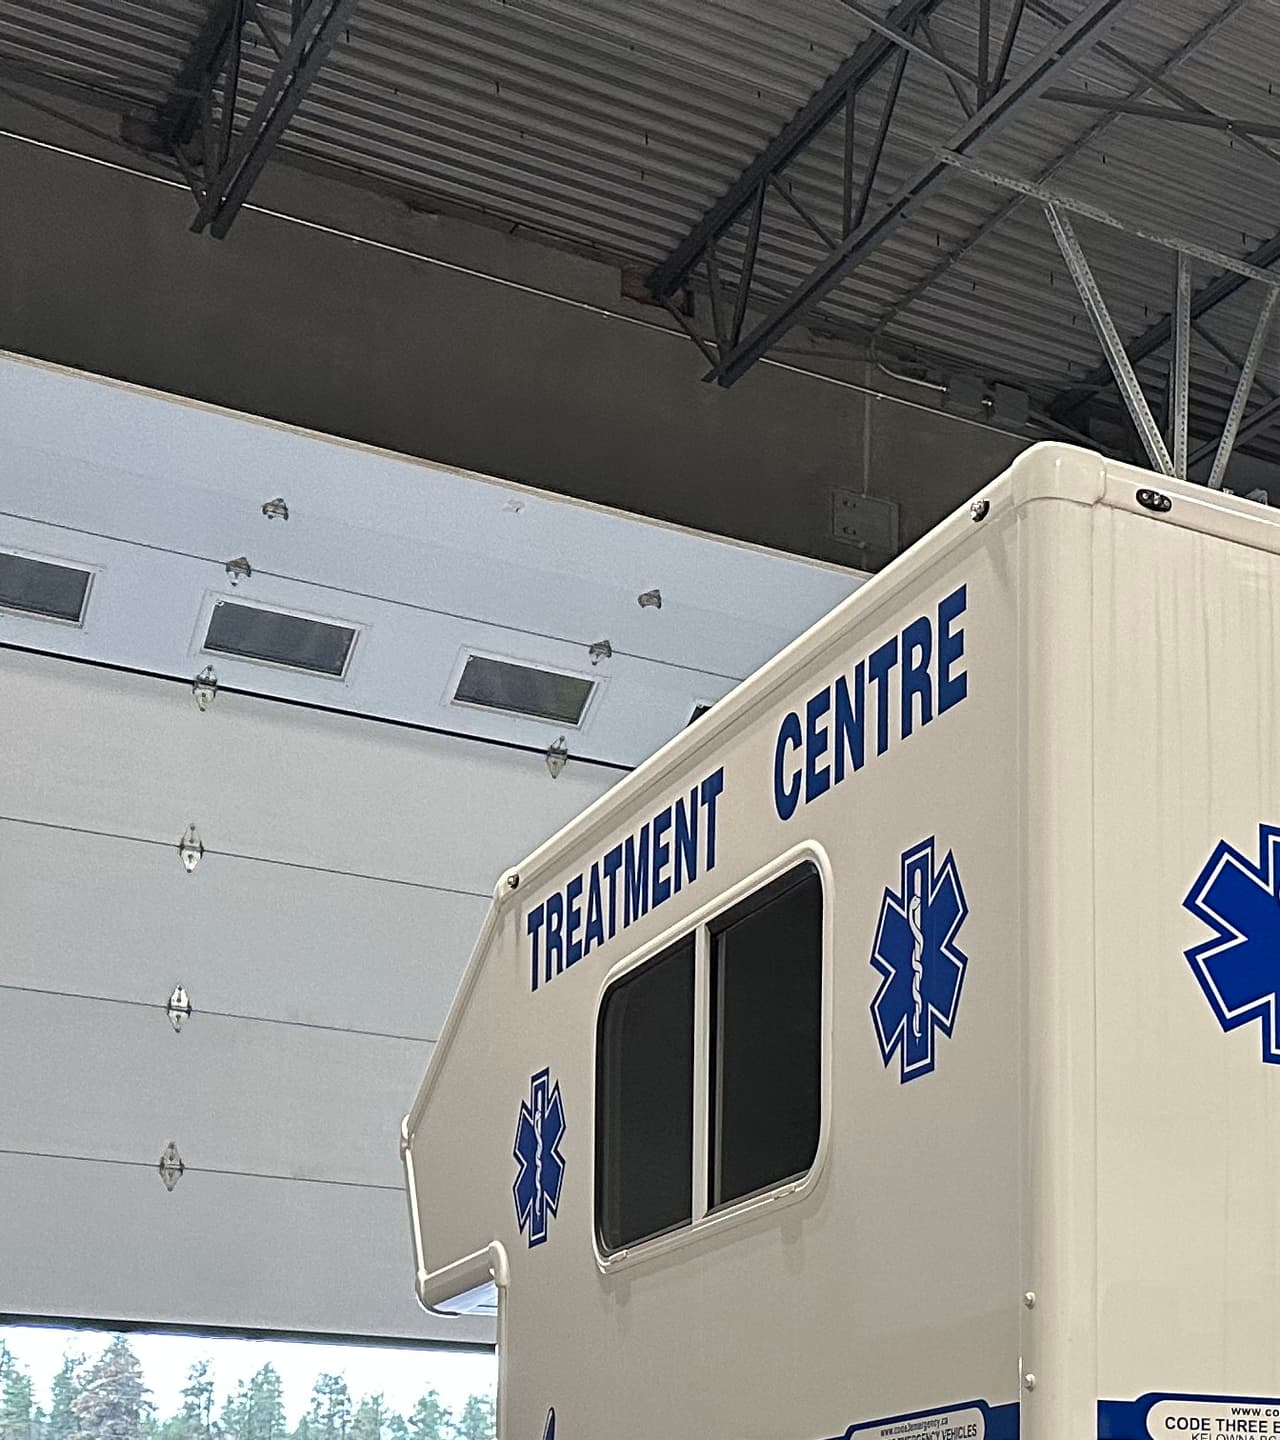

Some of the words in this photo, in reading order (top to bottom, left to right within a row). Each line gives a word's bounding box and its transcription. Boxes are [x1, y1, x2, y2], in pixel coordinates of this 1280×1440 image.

[527, 766, 725, 993] TREATMENT
[774, 583, 968, 822] CENTRE
[1165, 1416, 1212, 1431] CODE
[1215, 1418, 1269, 1433] THREE
